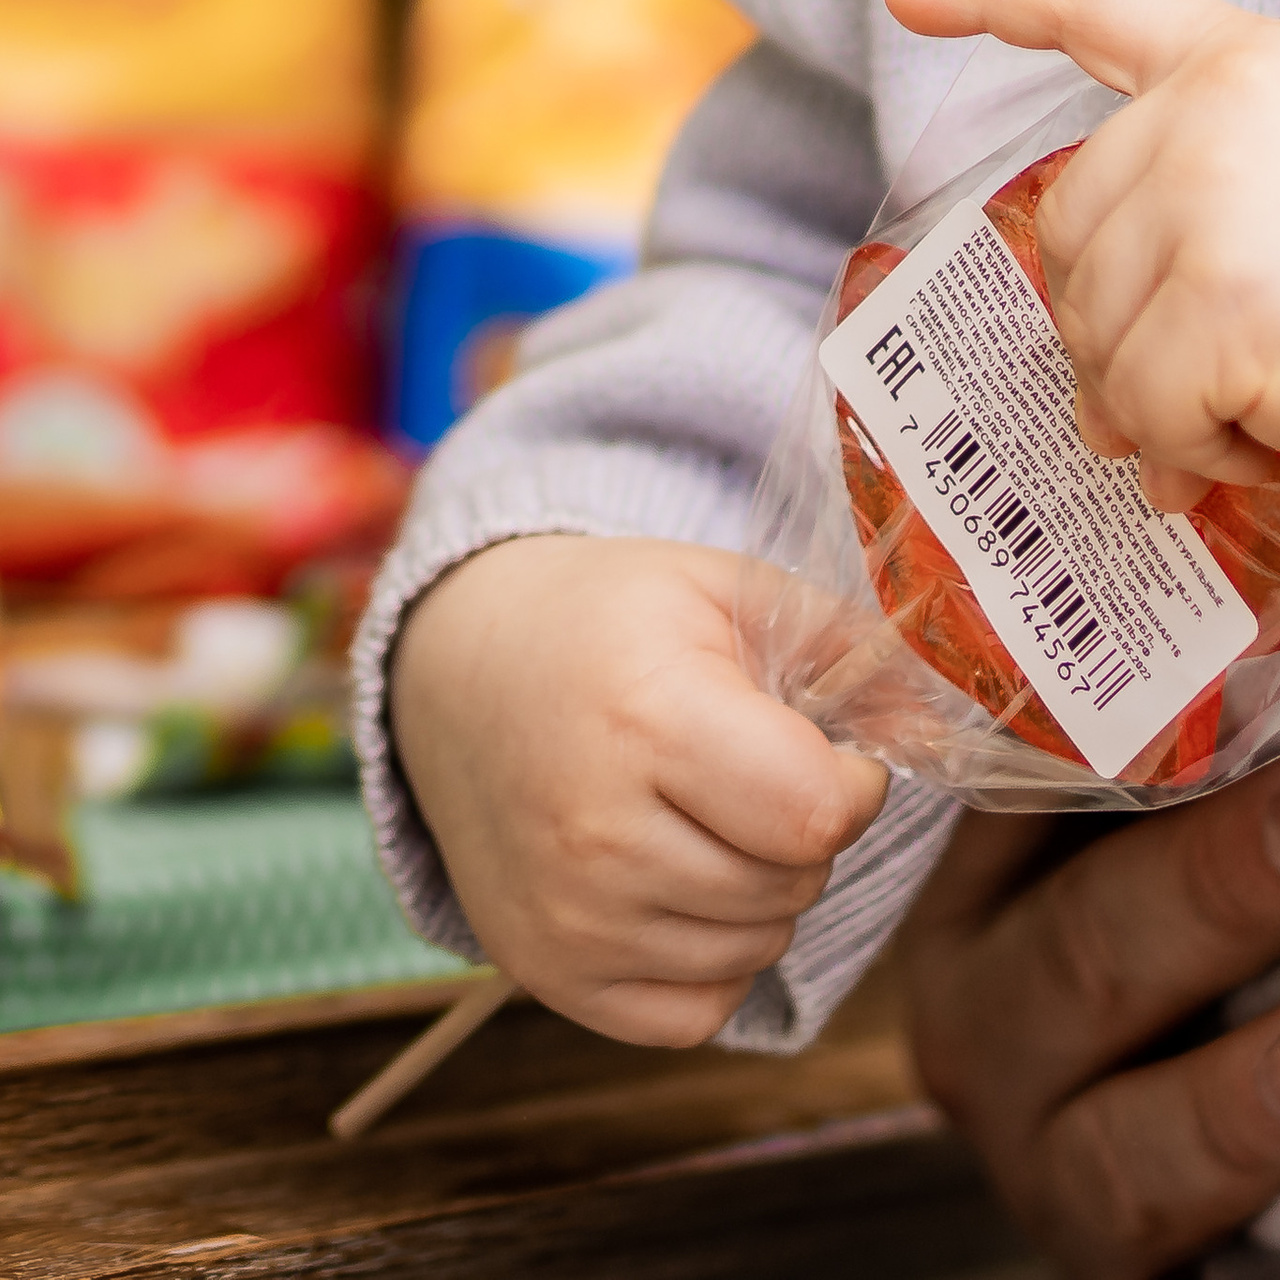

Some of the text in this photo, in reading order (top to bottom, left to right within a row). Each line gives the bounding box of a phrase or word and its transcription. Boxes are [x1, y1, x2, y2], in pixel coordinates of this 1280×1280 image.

[953, 250, 990, 304] ПИЩЕВАЯ
[992, 314, 1061, 408] ЭНЕРГЕТИЧЕСКАЯ
[1099, 464, 1113, 482] НА
[1110, 482, 1126, 502] 100
[1122, 500, 1136, 520] ГР.
[1133, 519, 1176, 582] УГЛЕВОДЫ
[1189, 602, 1204, 622] ГР.
[962, 241, 1027, 345] АРОМАТИЗАТОРЫ,
[1024, 343, 1070, 398] ПИЩЕВЫЕ
[1122, 478, 1152, 520] ГРАММ
[969, 230, 984, 250] ТМ
[982, 248, 1024, 312] "БРИМЕЛЬ"
[1020, 312, 1056, 362] СОСТАВ:
[1164, 523, 1224, 608] НАТУРАЛЬНЫЕ
[979, 225, 1014, 275] ЛЕДЕНЕЦ
[1036, 317, 1050, 334] ТУ
[994, 366, 1065, 461] ПРОИЗВОДИТЕЛЬ:
[1063, 460, 1084, 486] ООО
[904, 314, 926, 344] СРОК
[923, 344, 962, 403] ГОДНОСТИ
[959, 403, 970, 417] 12
[968, 416, 1009, 472] МЕСЯЦЕВ,
[1008, 470, 1064, 546] ИЗГОТОВЛЕНО
[1067, 555, 1112, 628] УПАКОВАНО:
[1110, 626, 1152, 681] 20.05.2022
[908, 297, 918, 310] Г.
[916, 308, 958, 376] ЧЕРЕПОВЕЦ,
[956, 374, 970, 396] УЛ.
[968, 394, 1002, 442] ГОГОЛЯ,
[1098, 585, 1151, 657] БРИМЕЛЬ.РФ
[915, 288, 970, 370] ЮРИДИЧЕСКИЙ
[964, 370, 994, 411] АДРЕС:
[992, 410, 1012, 435] ООО
[1080, 534, 1136, 617] ВОЛОГОДСКАЯ
[924, 278, 983, 370] ПРОИЗВОДСТВО:
[980, 368, 1040, 450] ВОЛОГОДСКАЯ
[1068, 486, 1111, 556] ЧЕРЕПОВЕЦ,
[1169, 642, 1182, 658] 16
[925, 460, 1009, 567] 450689
[1009, 579, 1090, 694] 744567
[1018, 376, 1058, 428] ХРАНИТЬ
[1056, 426, 1076, 451] ПРИ
[1109, 502, 1175, 598] ОТНОСИТЕЛЬНОЙ
